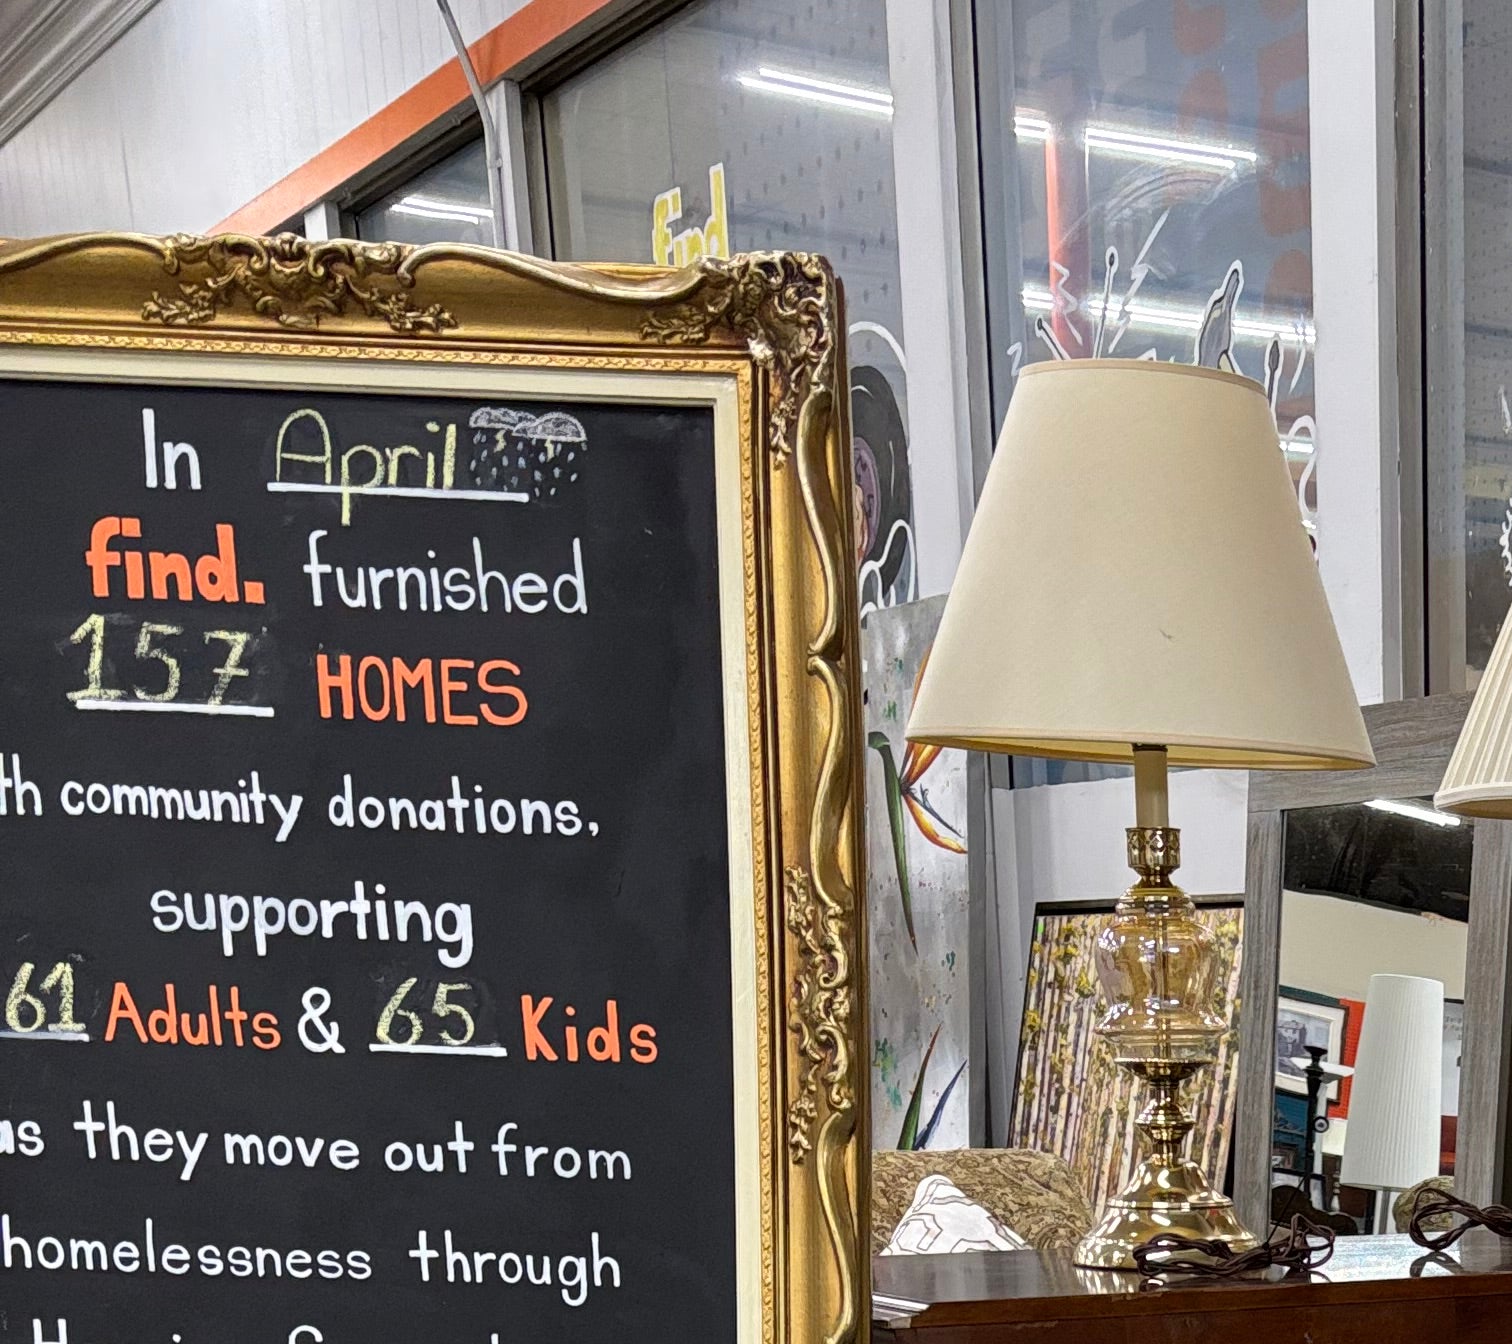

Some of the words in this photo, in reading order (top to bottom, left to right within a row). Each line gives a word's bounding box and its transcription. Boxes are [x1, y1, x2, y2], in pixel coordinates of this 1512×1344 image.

[142, 408, 201, 489] In
[276, 408, 457, 525] April
[85, 516, 265, 604] find.
[303, 530, 588, 614] furnished
[66, 613, 250, 704] 157
[317, 654, 529, 725] HOMES
[61, 771, 303, 842] community
[329, 774, 599, 836] donations,
[150, 881, 473, 968] supporting
[5, 962, 86, 1033] 61
[105, 982, 281, 1049] Adults
[298, 987, 346, 1054] &
[374, 978, 476, 1045] 65
[521, 995, 659, 1063] Kids
[73, 1100, 208, 1180] they
[224, 1133, 360, 1170] move
[385, 1121, 475, 1173] out
[491, 1123, 632, 1180] from
[1, 1214, 372, 1280] homelessness
[408, 1230, 621, 1306] through
